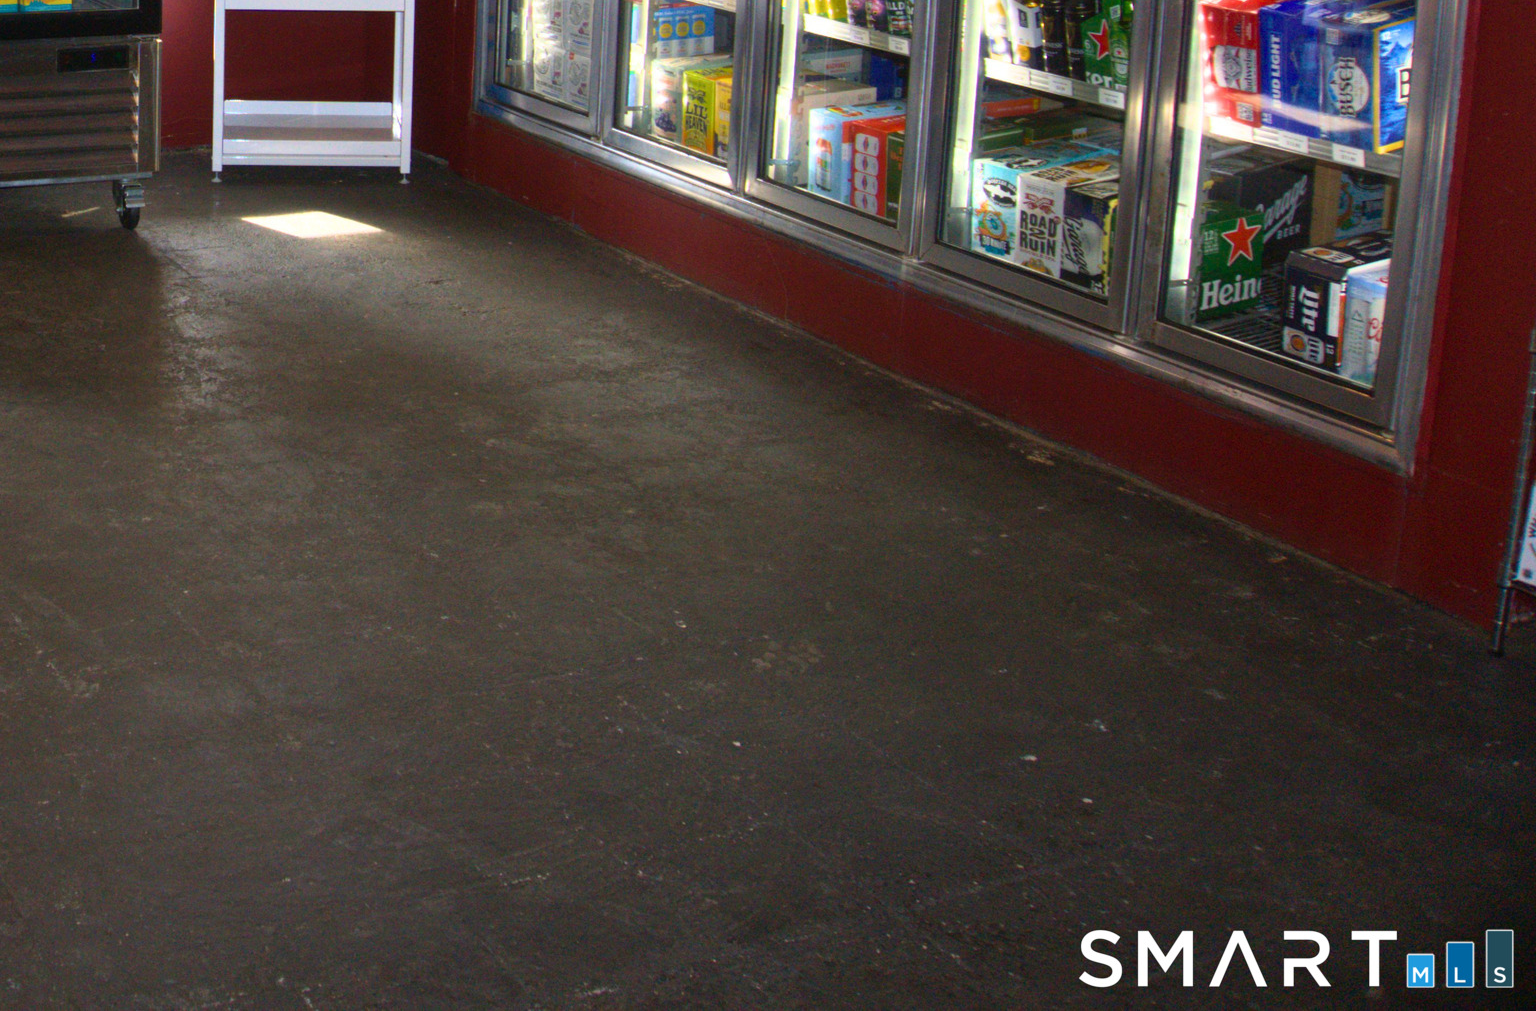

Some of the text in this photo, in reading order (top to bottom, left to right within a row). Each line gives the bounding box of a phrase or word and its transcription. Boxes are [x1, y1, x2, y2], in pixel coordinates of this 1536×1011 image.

[1271, 34, 1282, 109] BUD LIGHT
[1338, 56, 1357, 118] BUSCH
[1020, 210, 1058, 238] ROAD
[1277, 224, 1301, 240] BEER
[1019, 230, 1056, 257] RUIN
